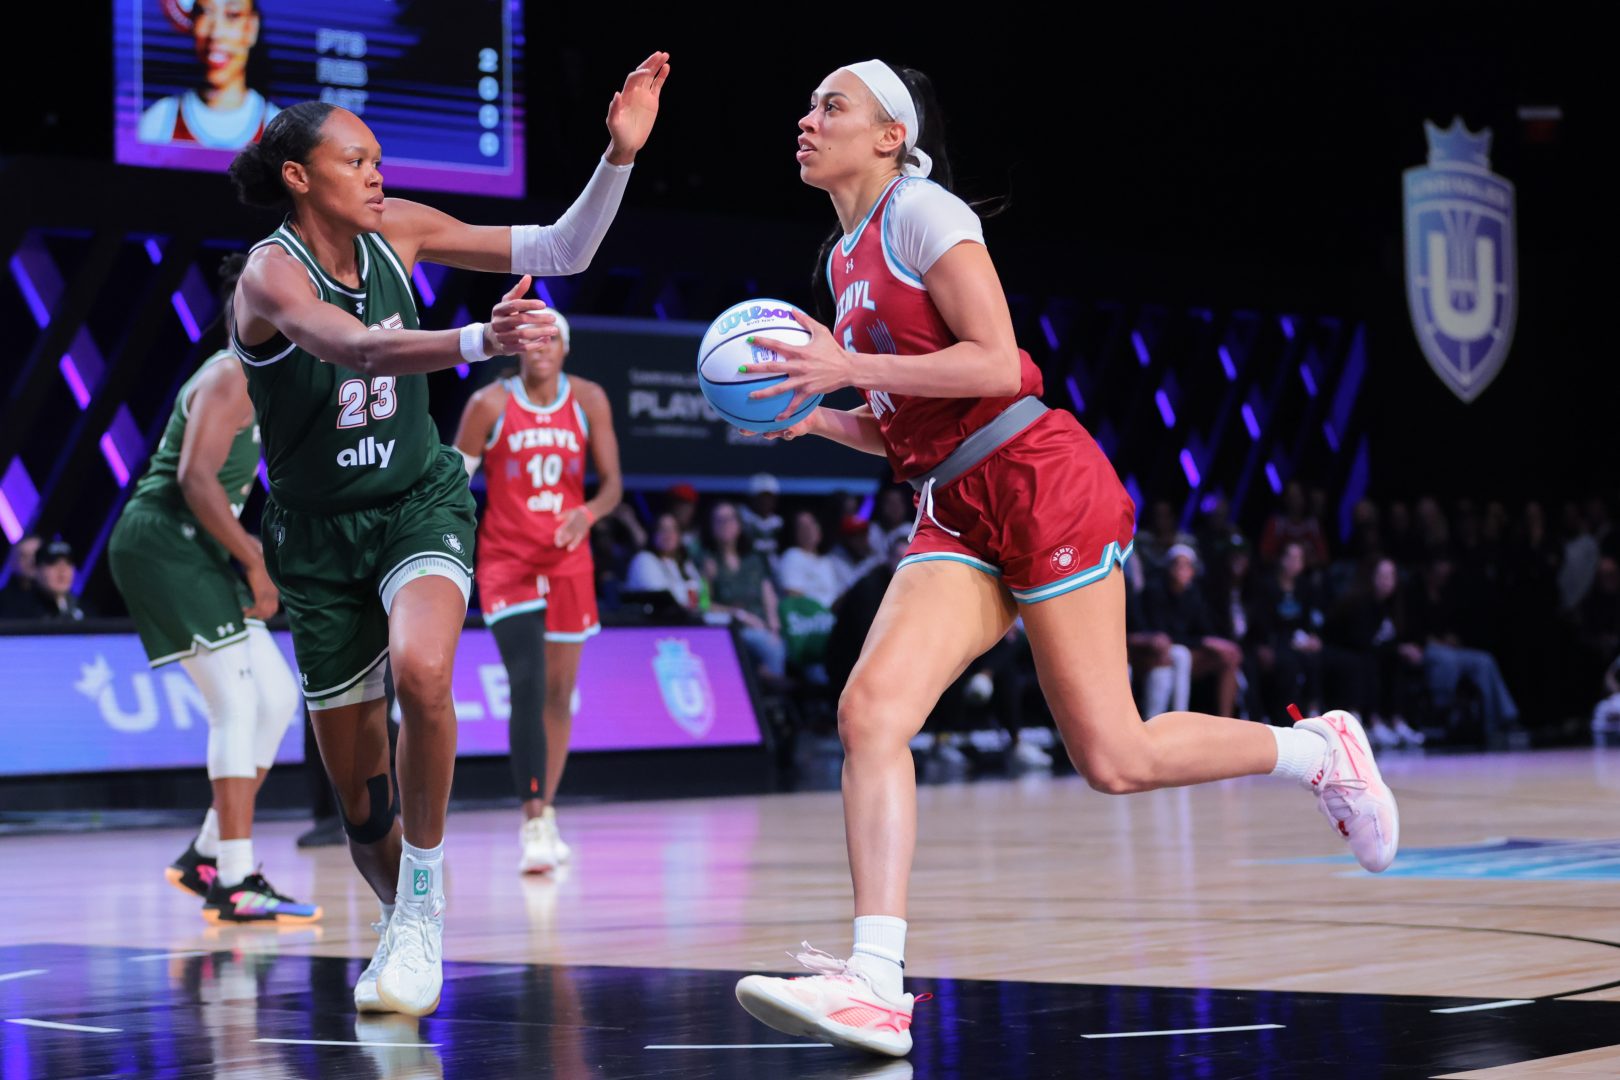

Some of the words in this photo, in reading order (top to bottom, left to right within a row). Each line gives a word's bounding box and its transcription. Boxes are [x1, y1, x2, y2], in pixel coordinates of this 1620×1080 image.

[337, 376, 397, 429] 23
[337, 437, 395, 468] ally
[507, 427, 580, 453] VINYL
[526, 453, 563, 489] 10
[1052, 547, 1074, 562] VINYL
